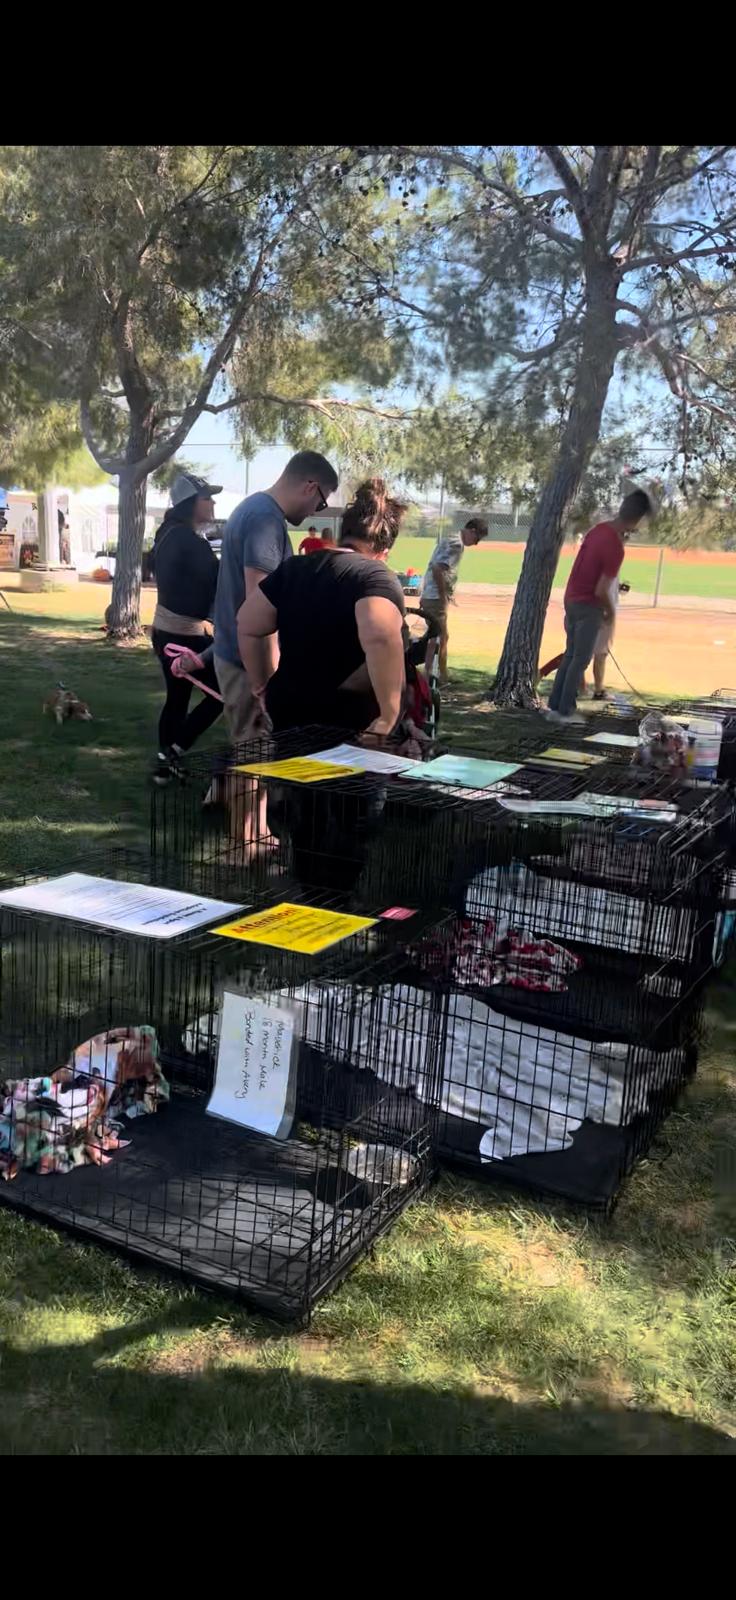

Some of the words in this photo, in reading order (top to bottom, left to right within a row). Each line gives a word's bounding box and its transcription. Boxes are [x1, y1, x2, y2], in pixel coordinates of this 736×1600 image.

[244, 1009, 257, 1046] Bonded
[262, 1016, 273, 1027] 18
[271, 1020, 285, 1070] Maverick
[234, 1070, 250, 1099] Avery
[258, 1064, 268, 1091] Male
